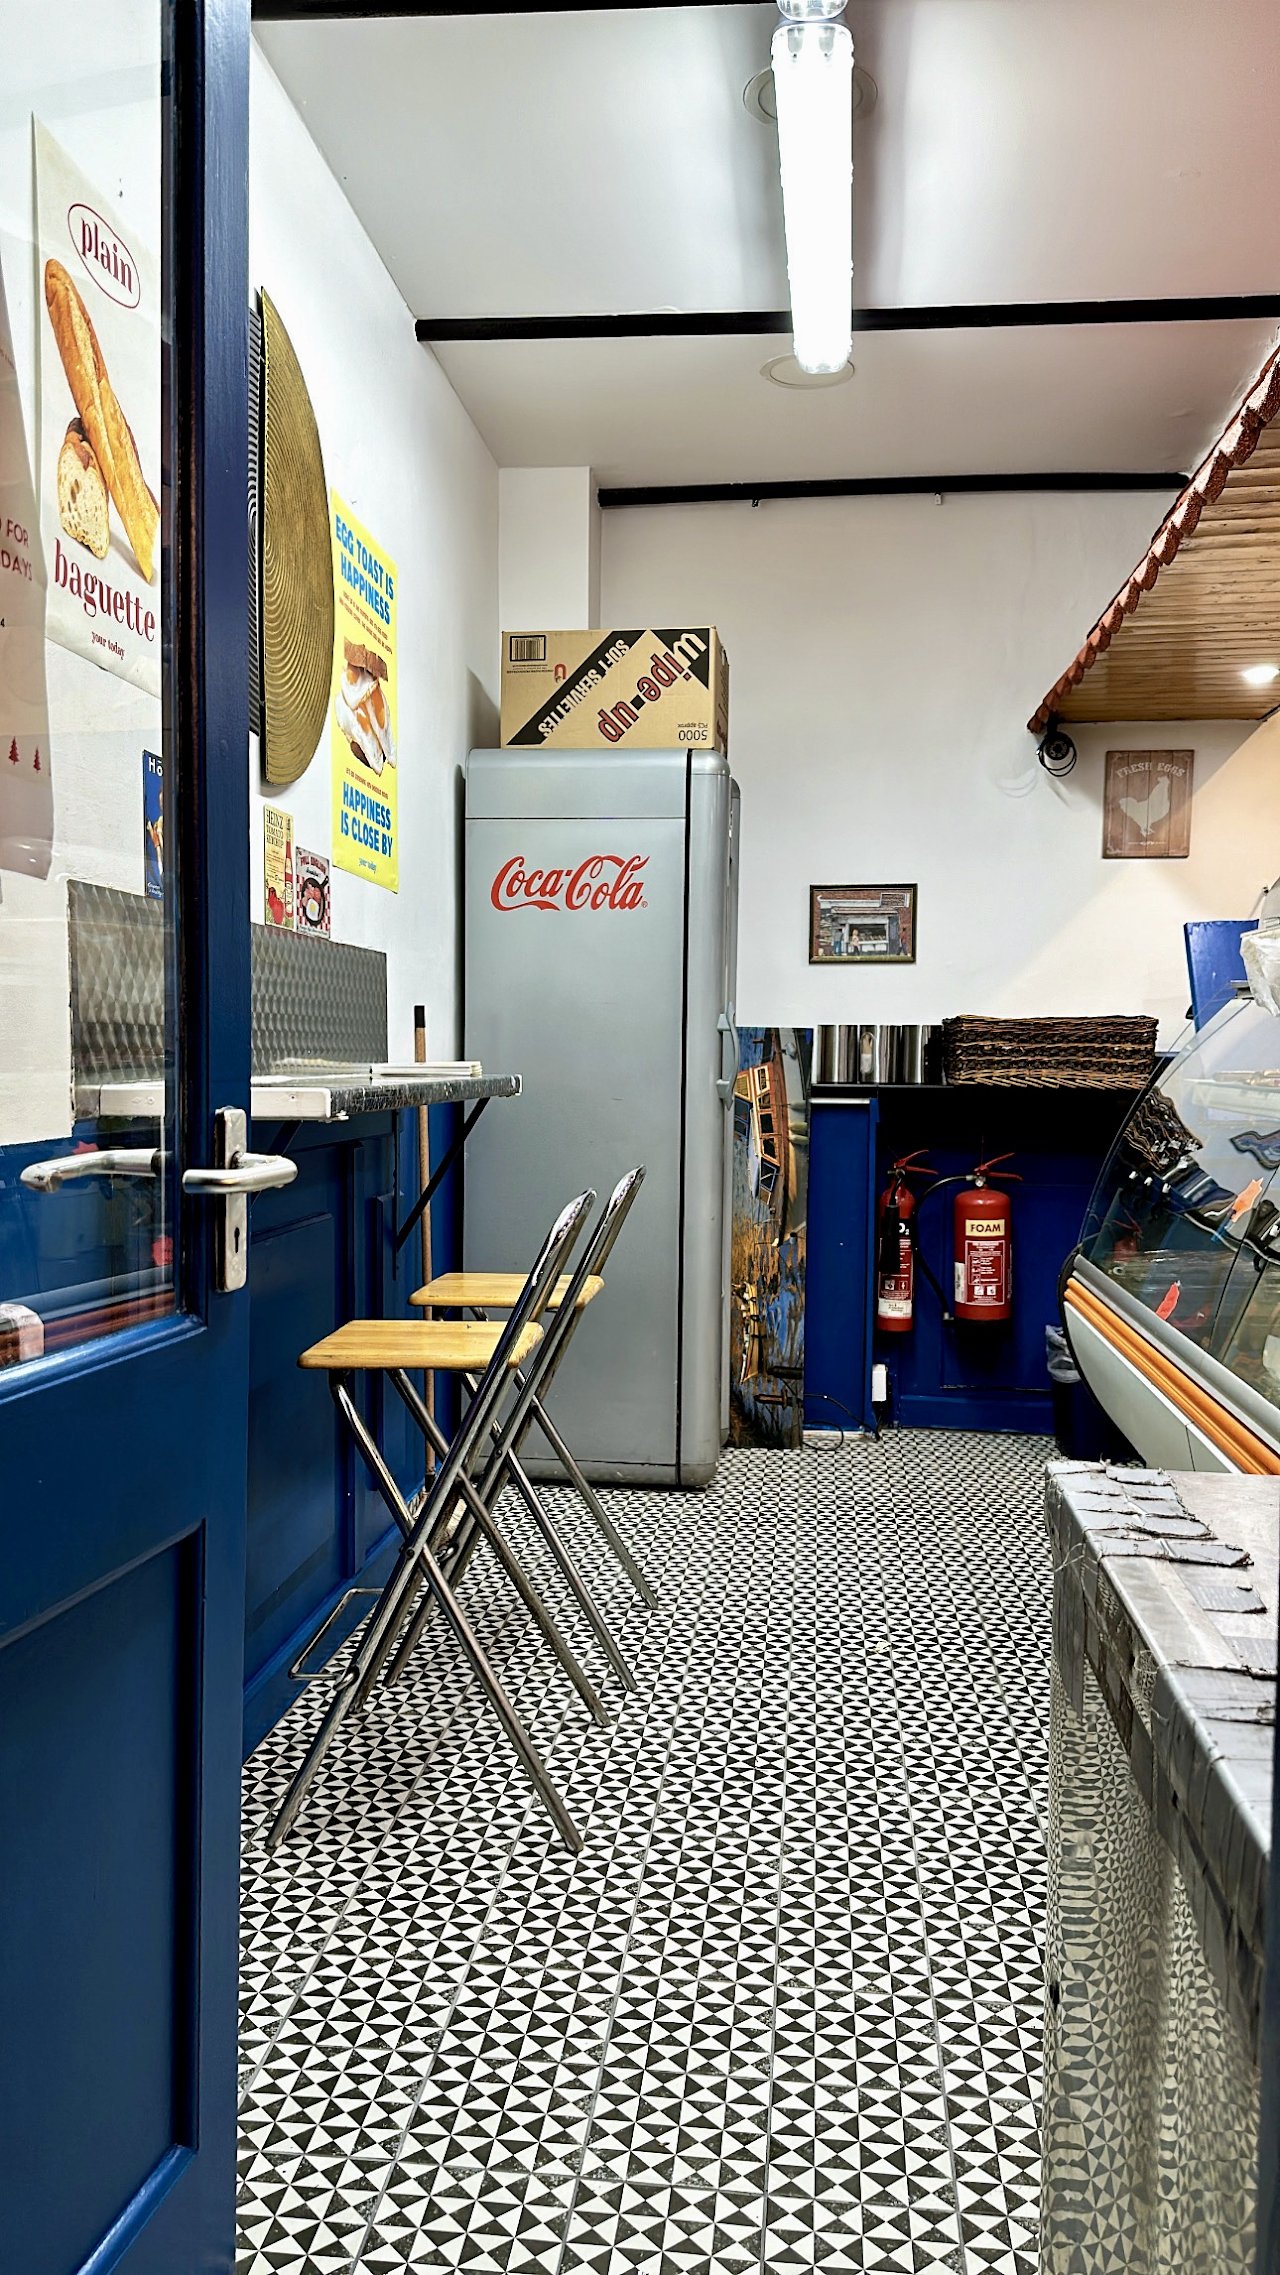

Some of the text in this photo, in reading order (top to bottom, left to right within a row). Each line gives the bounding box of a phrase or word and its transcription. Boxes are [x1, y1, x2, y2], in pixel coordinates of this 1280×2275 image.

[81, 217, 132, 293] plain
[7, 518, 28, 548] FOR
[335, 514, 354, 556] EGG
[356, 538, 384, 588] TOAST
[385, 573, 394, 600] IS
[55, 537, 155, 641] baguette
[340, 552, 390, 625] HAPPINESS
[91, 631, 125, 660] your today
[538, 639, 630, 737] SOFT SERVIETTES
[678, 729, 708, 741] 5000
[1115, 762, 1185, 778] FRESH EGGS
[266, 809, 283, 829] HEINZ
[343, 781, 391, 831] HAPPINESS
[340, 810, 393, 858] IS CLOSE BY
[491, 855, 650, 911] Coca-Cola
[970, 1223, 1001, 1233] FOAM
